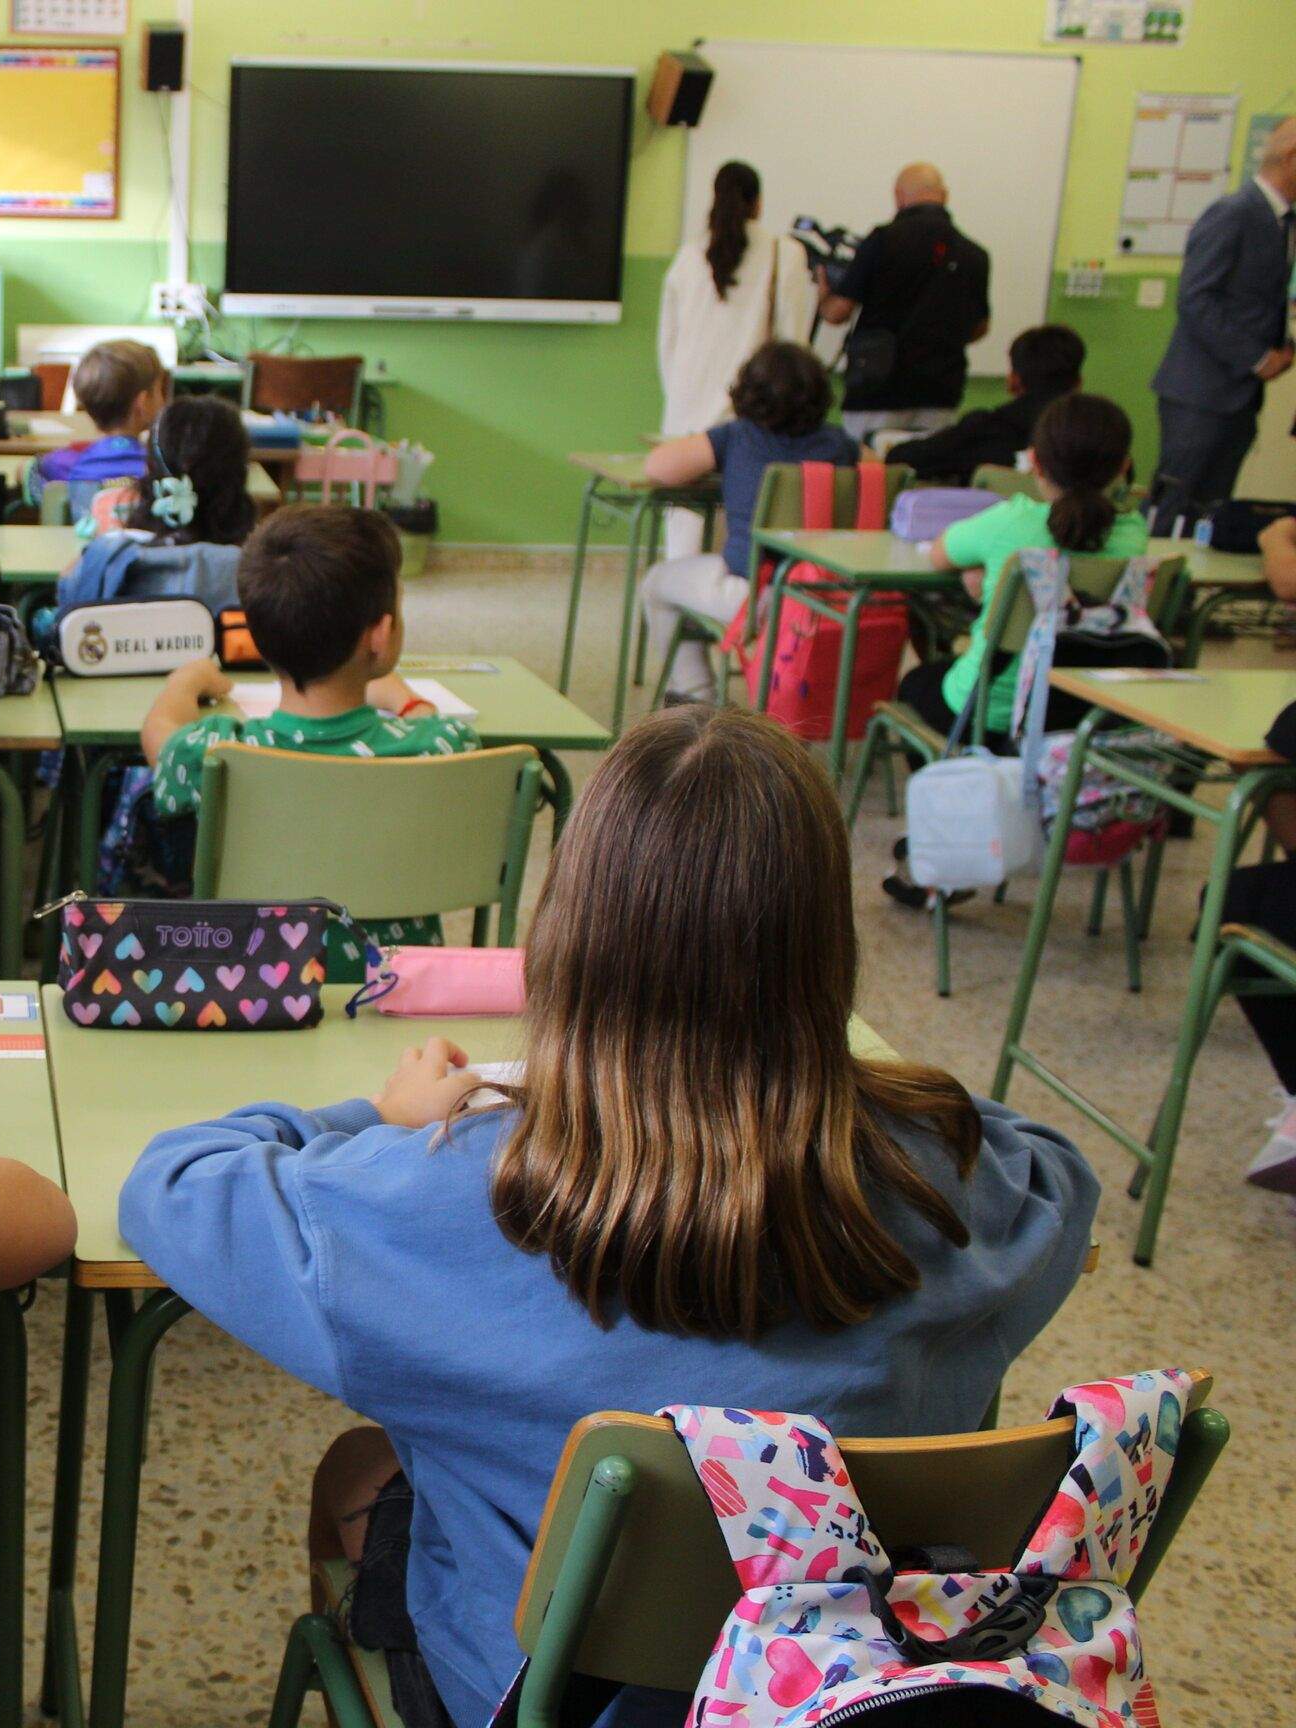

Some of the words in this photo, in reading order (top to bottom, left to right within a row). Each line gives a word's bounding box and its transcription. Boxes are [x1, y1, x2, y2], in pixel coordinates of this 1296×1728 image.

[115, 638, 147, 653] REAL
[155, 635, 204, 651] MADRID
[156, 921, 233, 948] TOTTO
